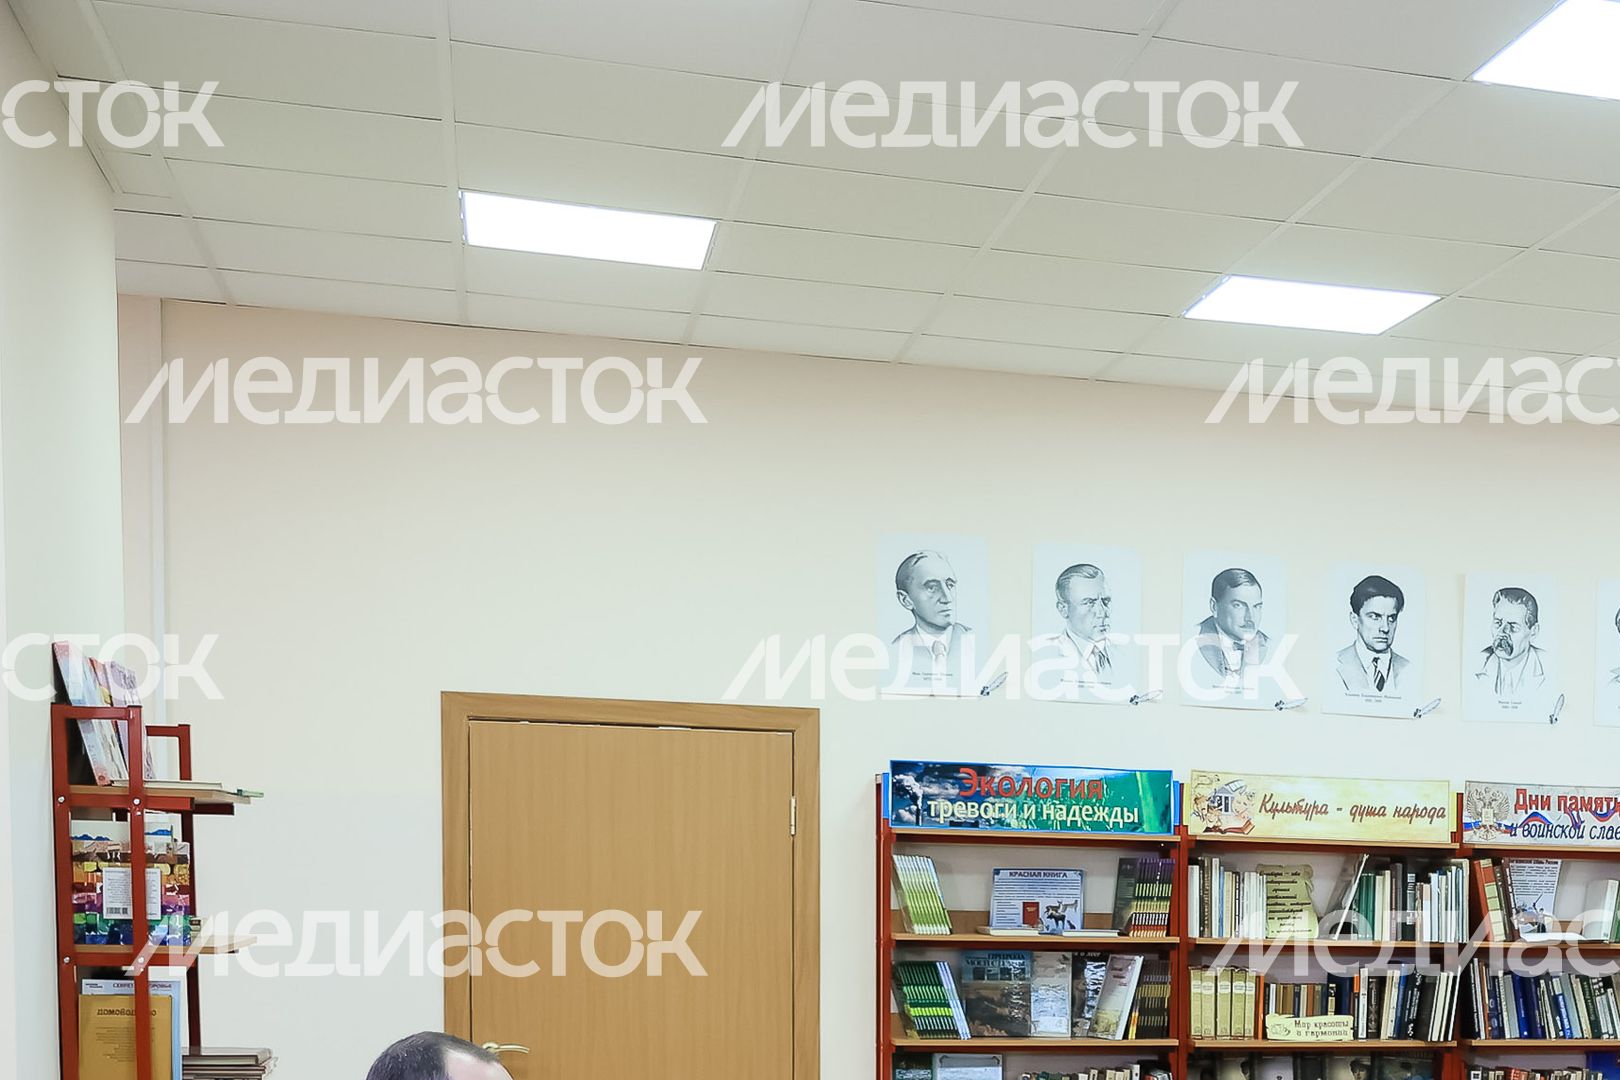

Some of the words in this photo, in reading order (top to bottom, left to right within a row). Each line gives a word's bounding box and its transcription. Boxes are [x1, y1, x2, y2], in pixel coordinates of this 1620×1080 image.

[1259, 793, 1329, 824] Культура
[1350, 802, 1387, 823] душа
[1393, 802, 1446, 825] народа
[1514, 788, 1551, 813] Дни
[927, 800, 1017, 825] тревоги
[1024, 804, 1036, 819] и
[1042, 802, 1139, 832] надежды
[1509, 822, 1518, 838] и
[1522, 821, 1585, 841] воинской
